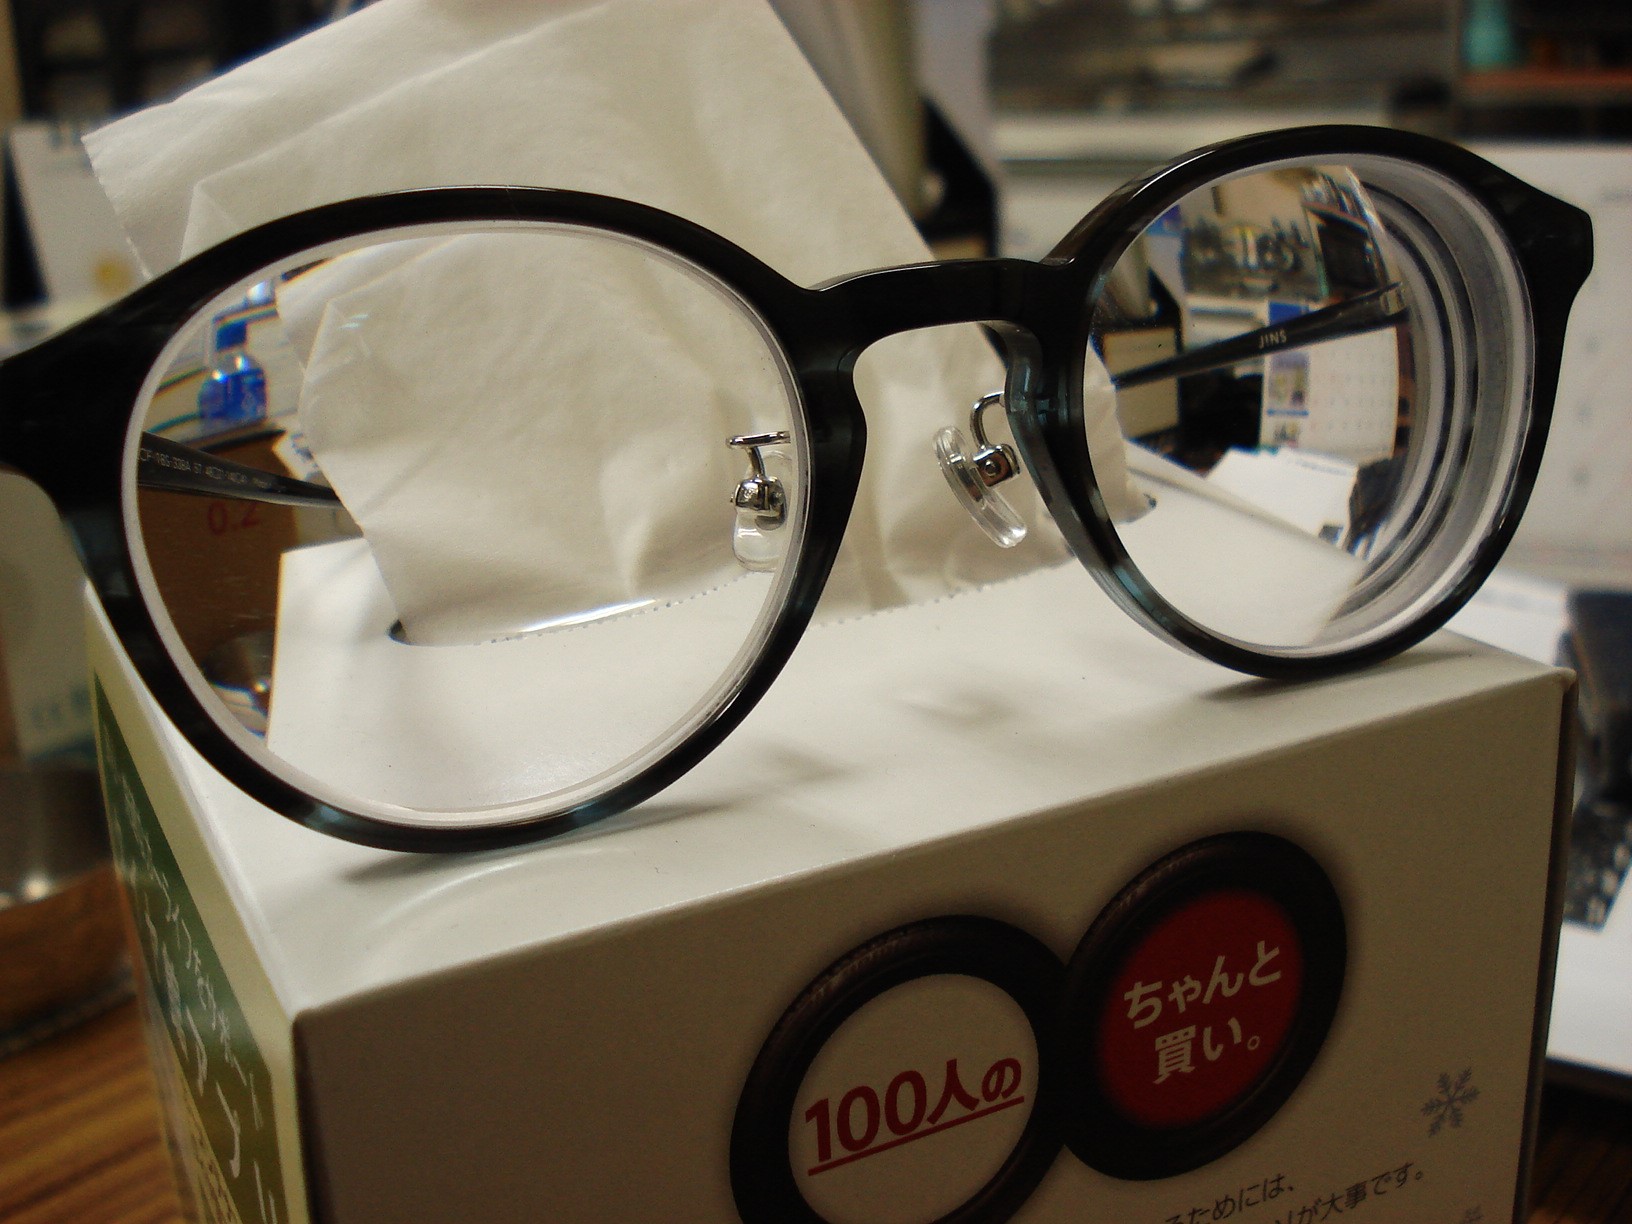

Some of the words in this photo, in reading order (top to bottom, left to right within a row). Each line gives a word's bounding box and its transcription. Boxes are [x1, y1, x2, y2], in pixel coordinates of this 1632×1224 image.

[1259, 328, 1288, 350] JINS
[1123, 939, 1282, 1030] ちゃんと
[1152, 1016, 1262, 1085] 買い。
[804, 1056, 1023, 1164] 100人の
